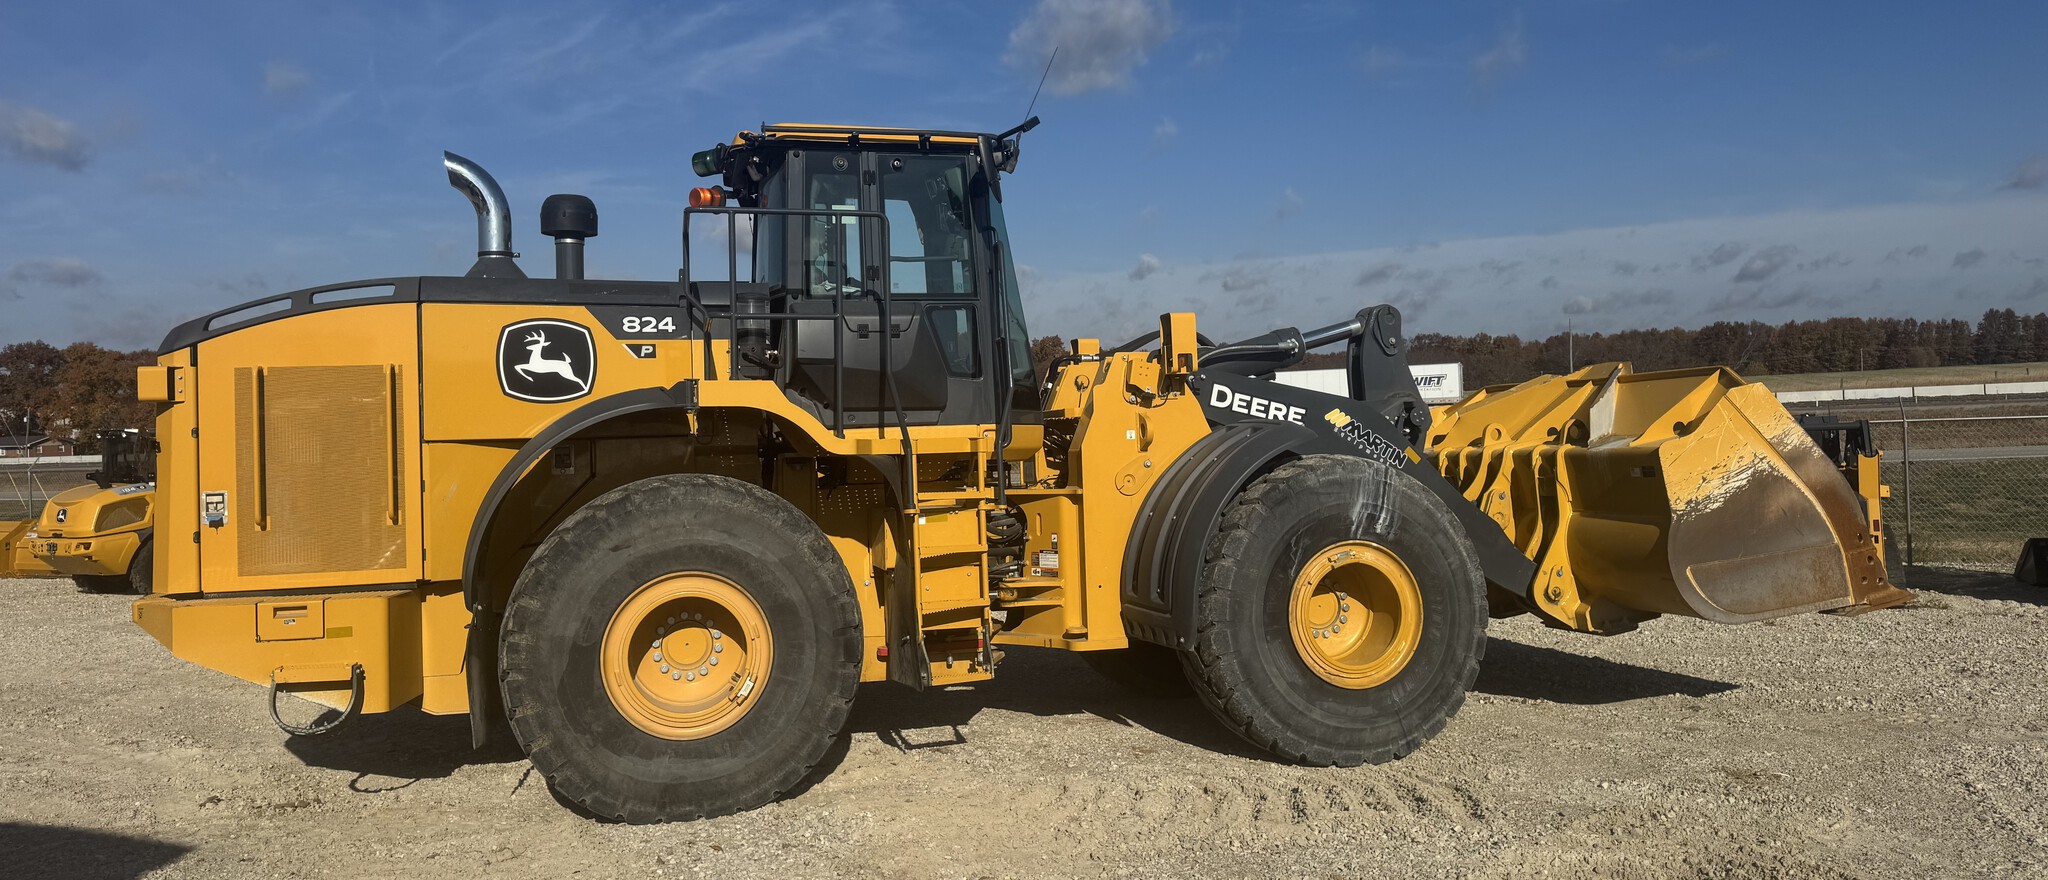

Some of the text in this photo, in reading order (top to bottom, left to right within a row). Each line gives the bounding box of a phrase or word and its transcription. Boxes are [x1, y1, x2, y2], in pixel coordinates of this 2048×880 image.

[622, 316, 676, 333] 824
[640, 345, 654, 357] P
[1414, 374, 1447, 387] WIFT
[1210, 383, 1307, 427] DEERE
[1341, 418, 1409, 469] MARTIN
